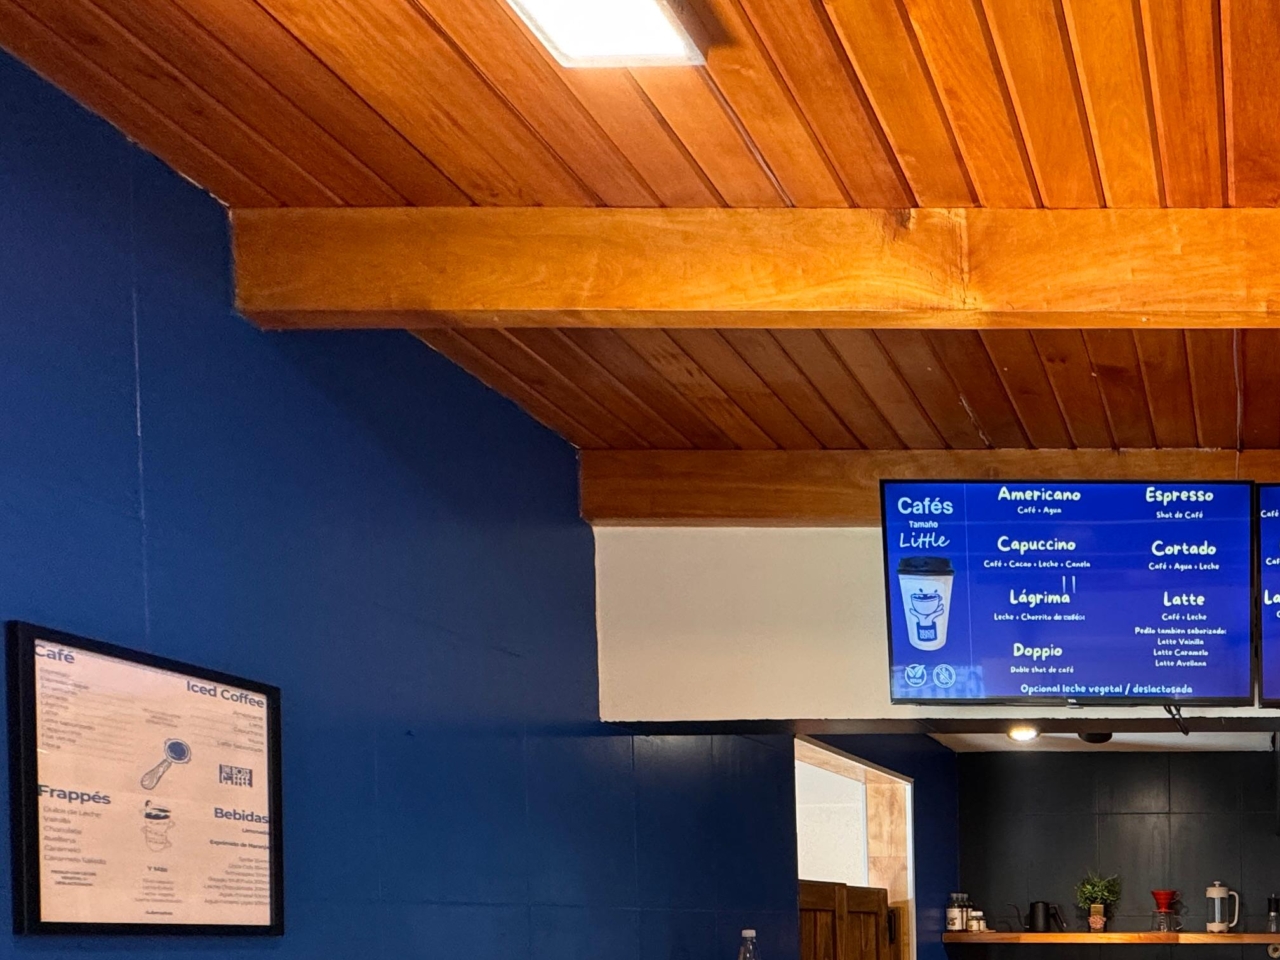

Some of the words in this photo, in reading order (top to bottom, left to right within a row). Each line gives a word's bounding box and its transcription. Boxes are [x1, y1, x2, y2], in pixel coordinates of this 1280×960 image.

[997, 485, 1081, 501] Americano
[1145, 486, 1214, 506] Espresso
[897, 496, 954, 515] Cafés
[1017, 505, 1036, 514] Café
[1043, 506, 1062, 515] Agua
[1156, 510, 1173, 519] Shot
[1174, 510, 1183, 518] de
[1184, 510, 1204, 519] Café
[1260, 509, 1279, 518] Café
[908, 520, 939, 529] Tamaño
[899, 531, 951, 549] Little
[997, 535, 1076, 555] Capuccino
[1151, 539, 1217, 556] Cortado
[983, 559, 1002, 568] Café
[1008, 559, 1032, 568] Cacao
[1038, 559, 1059, 568] Leche
[1065, 559, 1091, 568] Canela
[1148, 562, 1167, 570] Café
[1173, 562, 1193, 572] Agua
[1199, 562, 1220, 570] Leche
[1009, 588, 1071, 608] Lágrima
[1163, 590, 1205, 607] Latte
[993, 612, 1014, 621] Leche
[1020, 612, 1052, 621] Chorrito
[1161, 612, 1180, 621] Café
[1186, 612, 1207, 621] Leche
[1157, 637, 1177, 645] Latte
[35, 643, 75, 664] Café
[1013, 642, 1063, 661] Doppio
[1153, 648, 1173, 656] Latte
[1174, 648, 1209, 656] Caramelo
[1010, 665, 1030, 674] Doble
[1031, 665, 1047, 673] shot
[1048, 665, 1057, 673] de
[1058, 665, 1074, 674] café
[1155, 659, 1175, 667] Latte
[186, 680, 217, 698] Iced
[220, 689, 265, 709] Coffee
[1020, 683, 1060, 695] Opcional
[1062, 683, 1087, 694] leche
[1088, 684, 1123, 695] vegetal
[1132, 684, 1193, 694] deslactosada
[38, 784, 111, 805] Frappés
[214, 807, 269, 824] Bebidas
